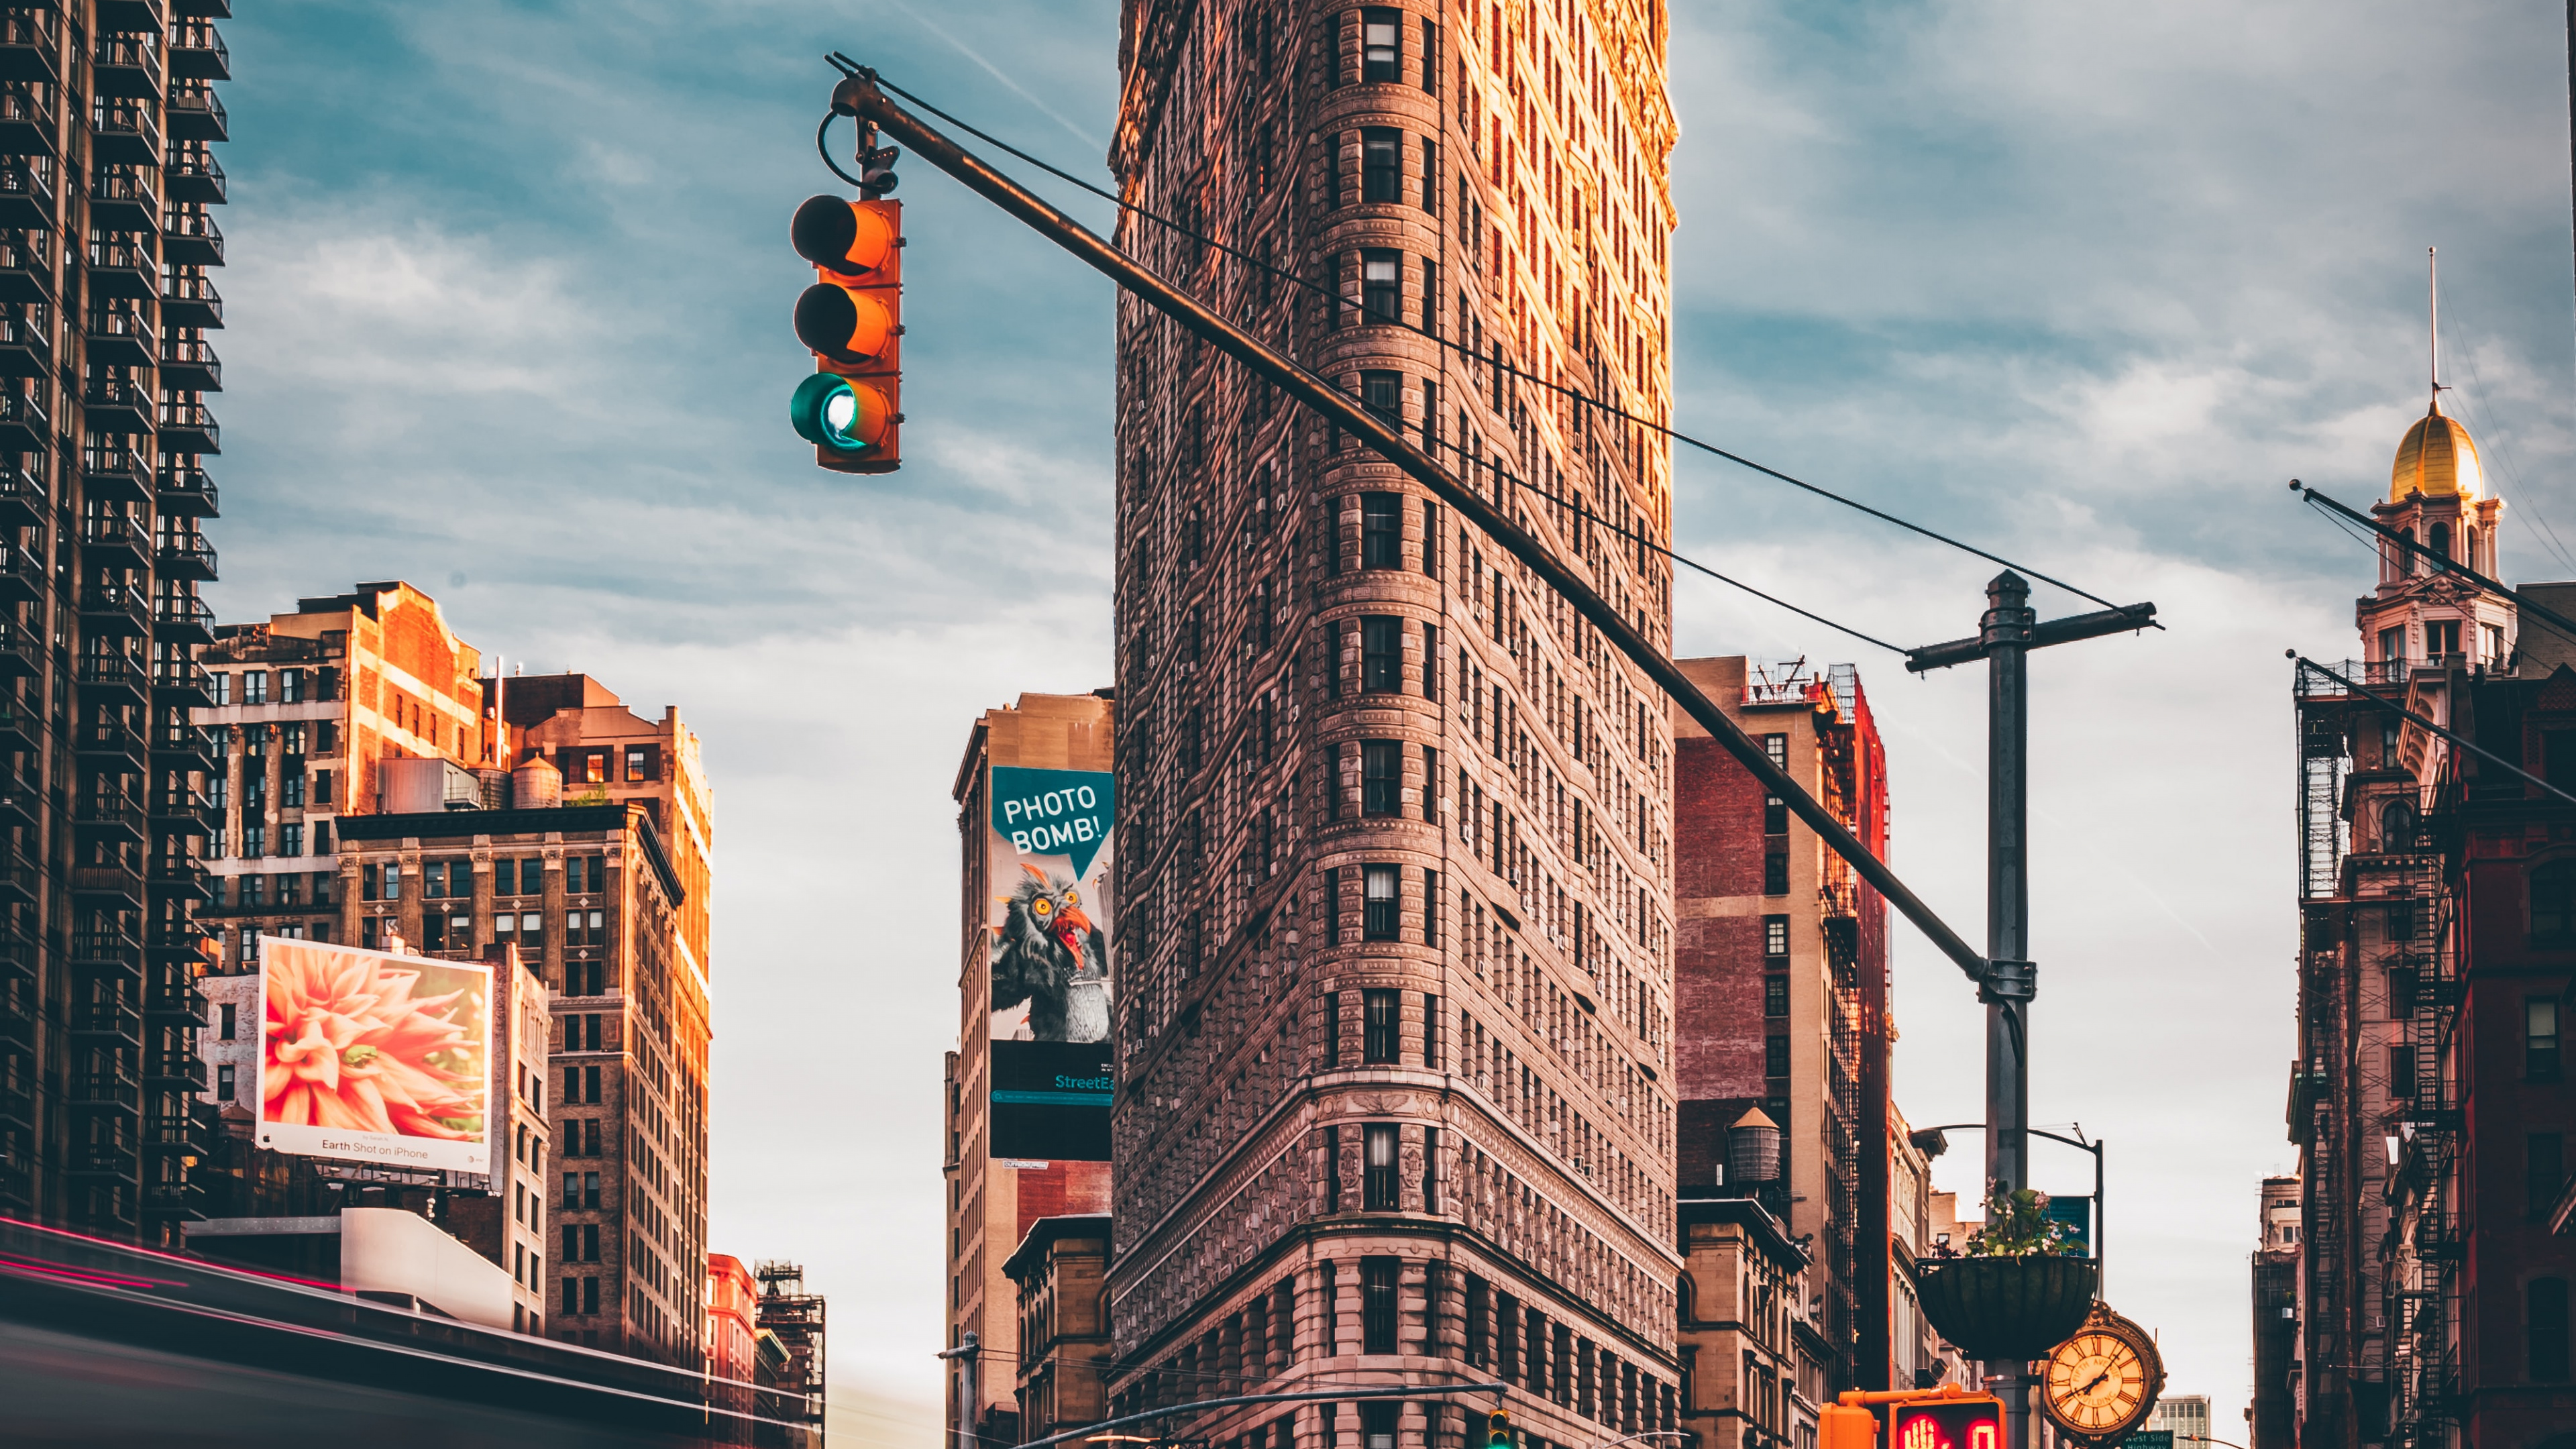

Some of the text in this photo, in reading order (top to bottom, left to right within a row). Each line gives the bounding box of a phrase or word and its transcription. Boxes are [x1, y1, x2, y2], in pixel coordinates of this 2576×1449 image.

[1004, 786, 1096, 824] PHOTO
[1012, 816, 1102, 855] BOMB!
[323, 1140, 429, 1159] Earth Shot on iPhone
[2073, 1361, 2090, 1382] FIFTH
[2151, 1434, 2169, 1442] Side
